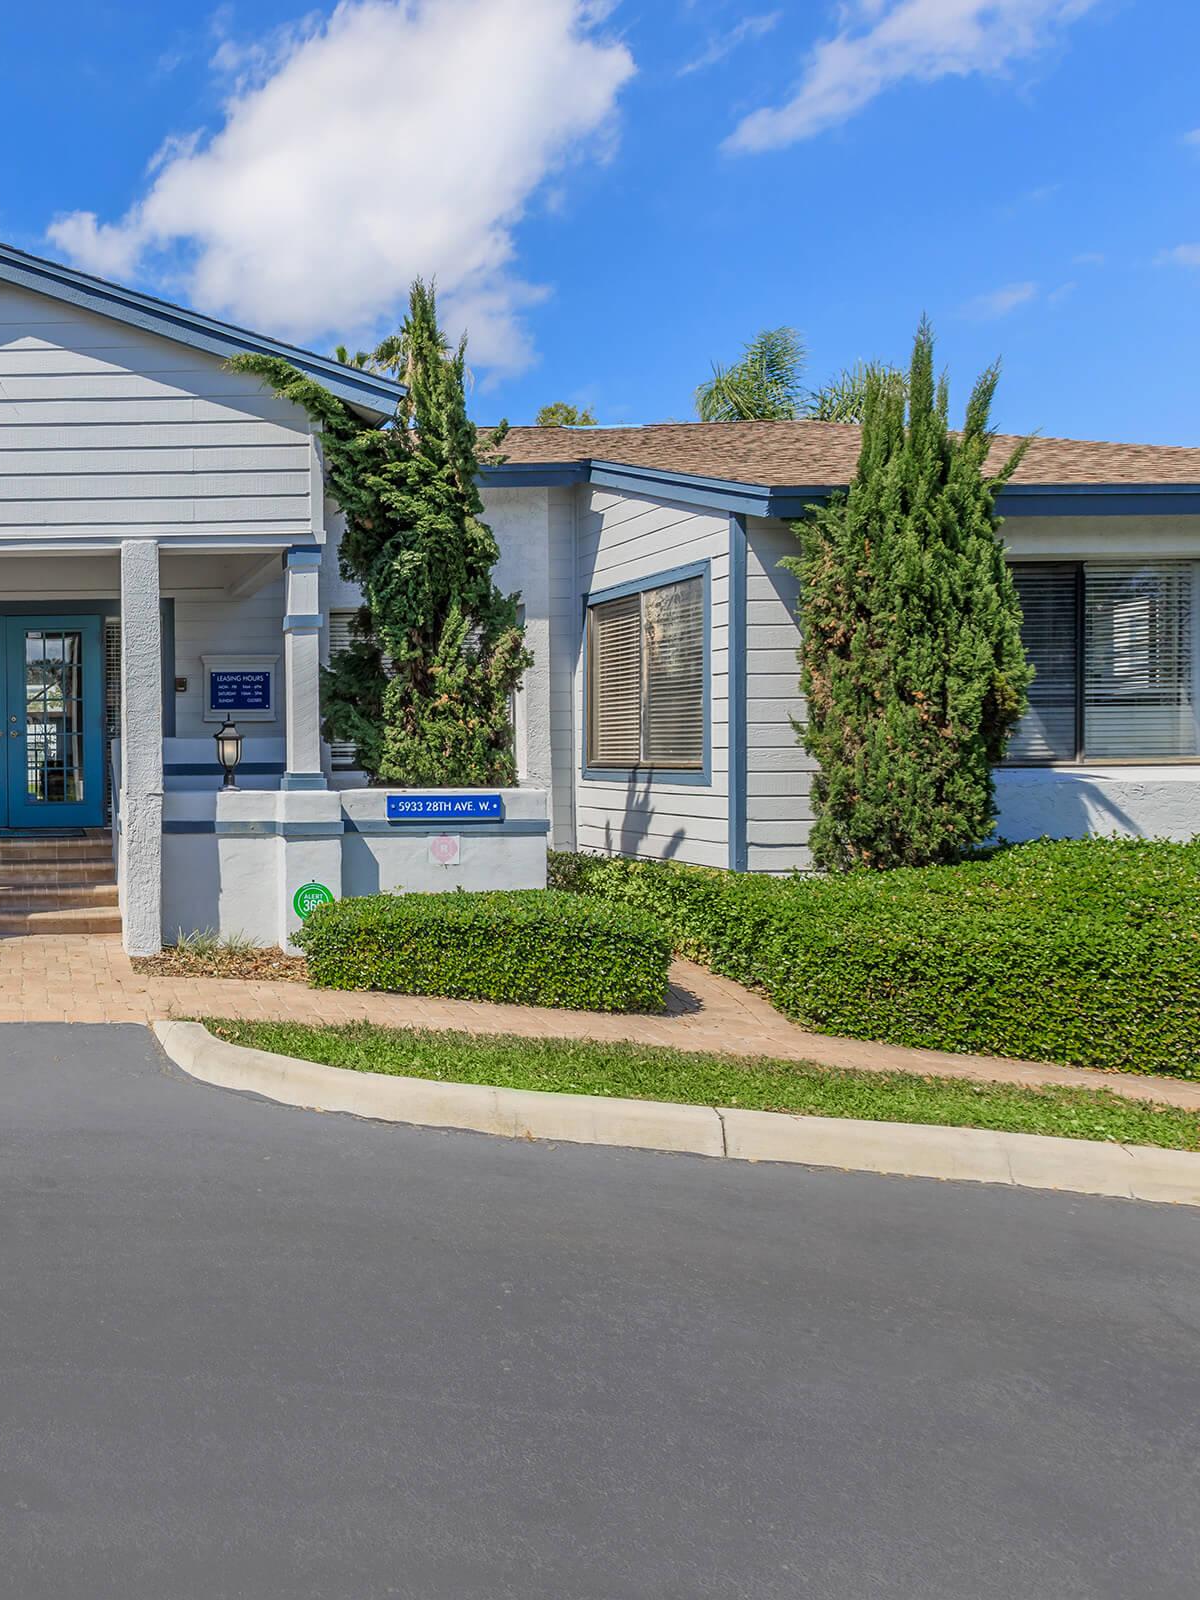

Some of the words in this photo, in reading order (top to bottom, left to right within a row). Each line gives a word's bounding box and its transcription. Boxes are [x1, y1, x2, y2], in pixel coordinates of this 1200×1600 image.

[398, 801, 423, 812] 5933
[426, 801, 451, 812] 28TH
[453, 801, 476, 811] AVE.
[478, 801, 491, 811] W.
